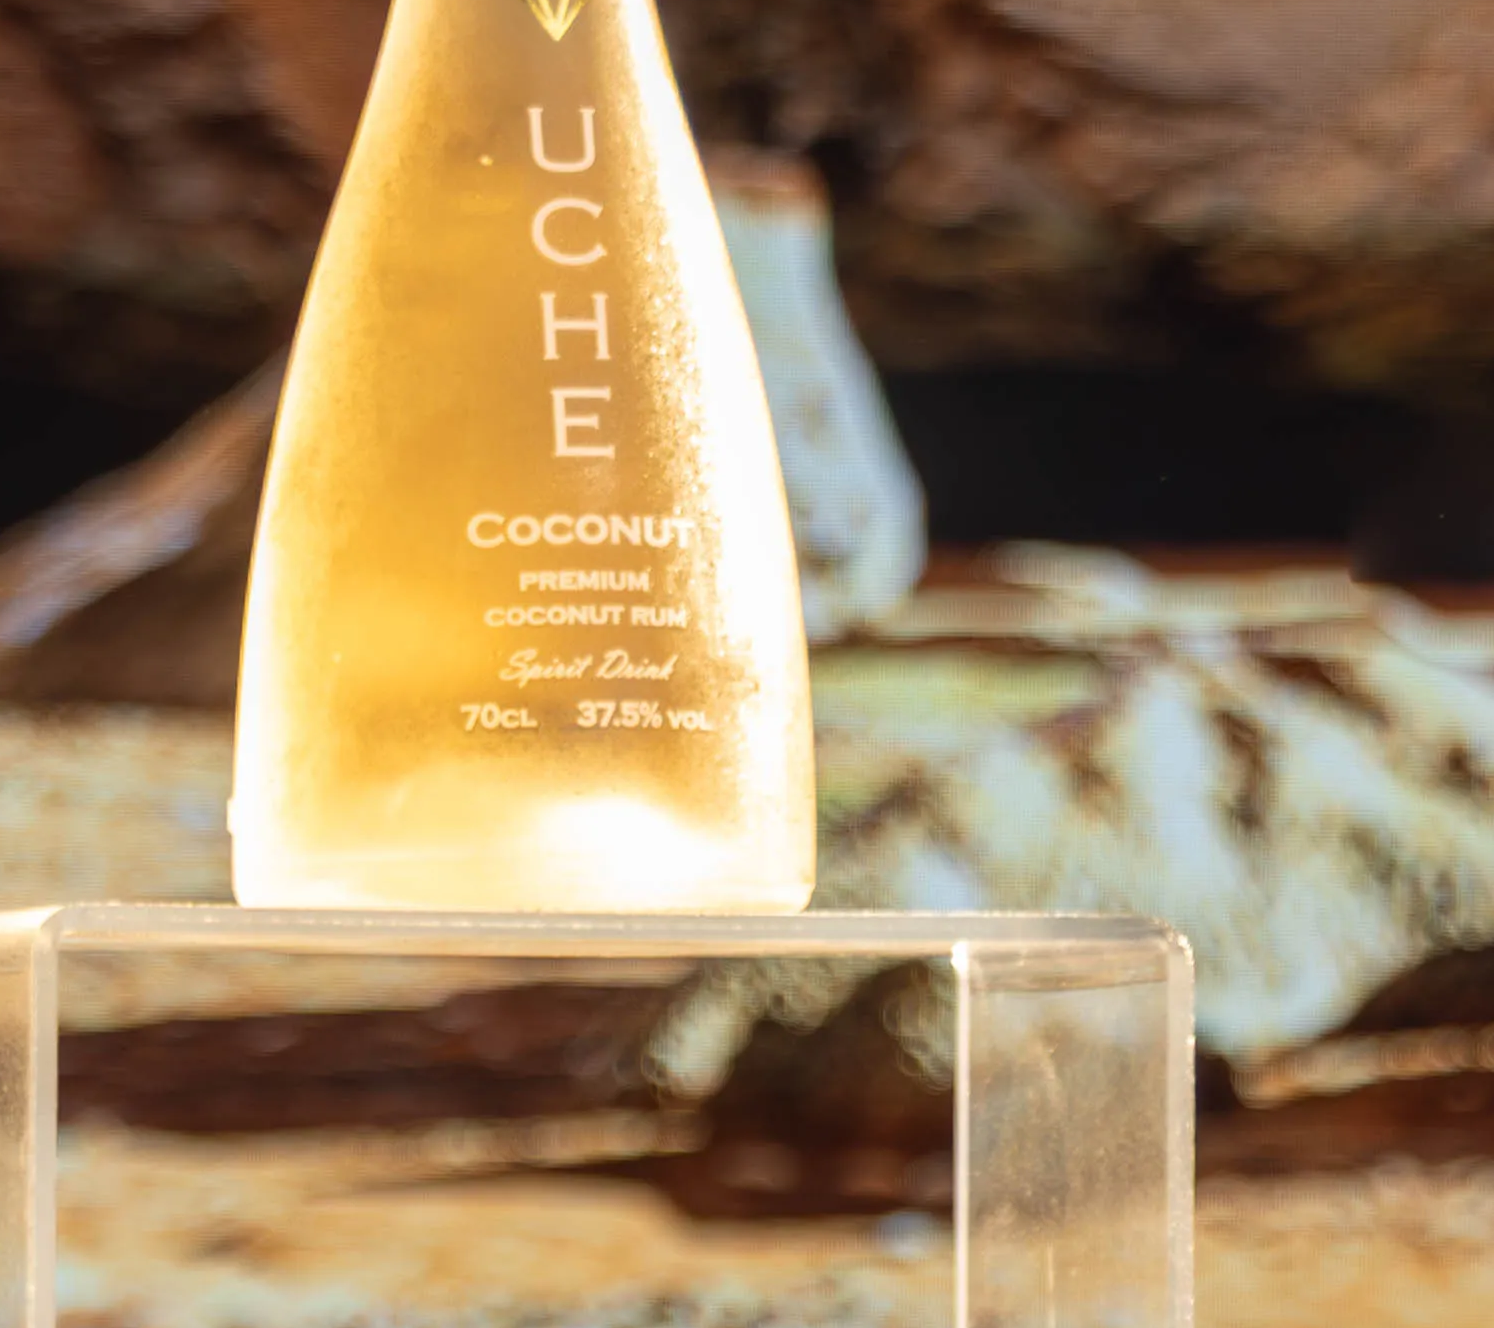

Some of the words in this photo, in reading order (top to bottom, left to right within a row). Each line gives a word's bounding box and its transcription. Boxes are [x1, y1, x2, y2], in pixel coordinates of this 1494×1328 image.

[526, 106, 616, 458] UCHE
[466, 512, 697, 549] COCONUT
[518, 569, 651, 592] PREMIUM
[482, 604, 626, 627] COCONUT
[630, 605, 688, 629] RUM
[498, 647, 593, 689] Spirit
[595, 649, 679, 681] Drink
[459, 702, 539, 731] 70CL
[576, 700, 663, 729] 37.5%
